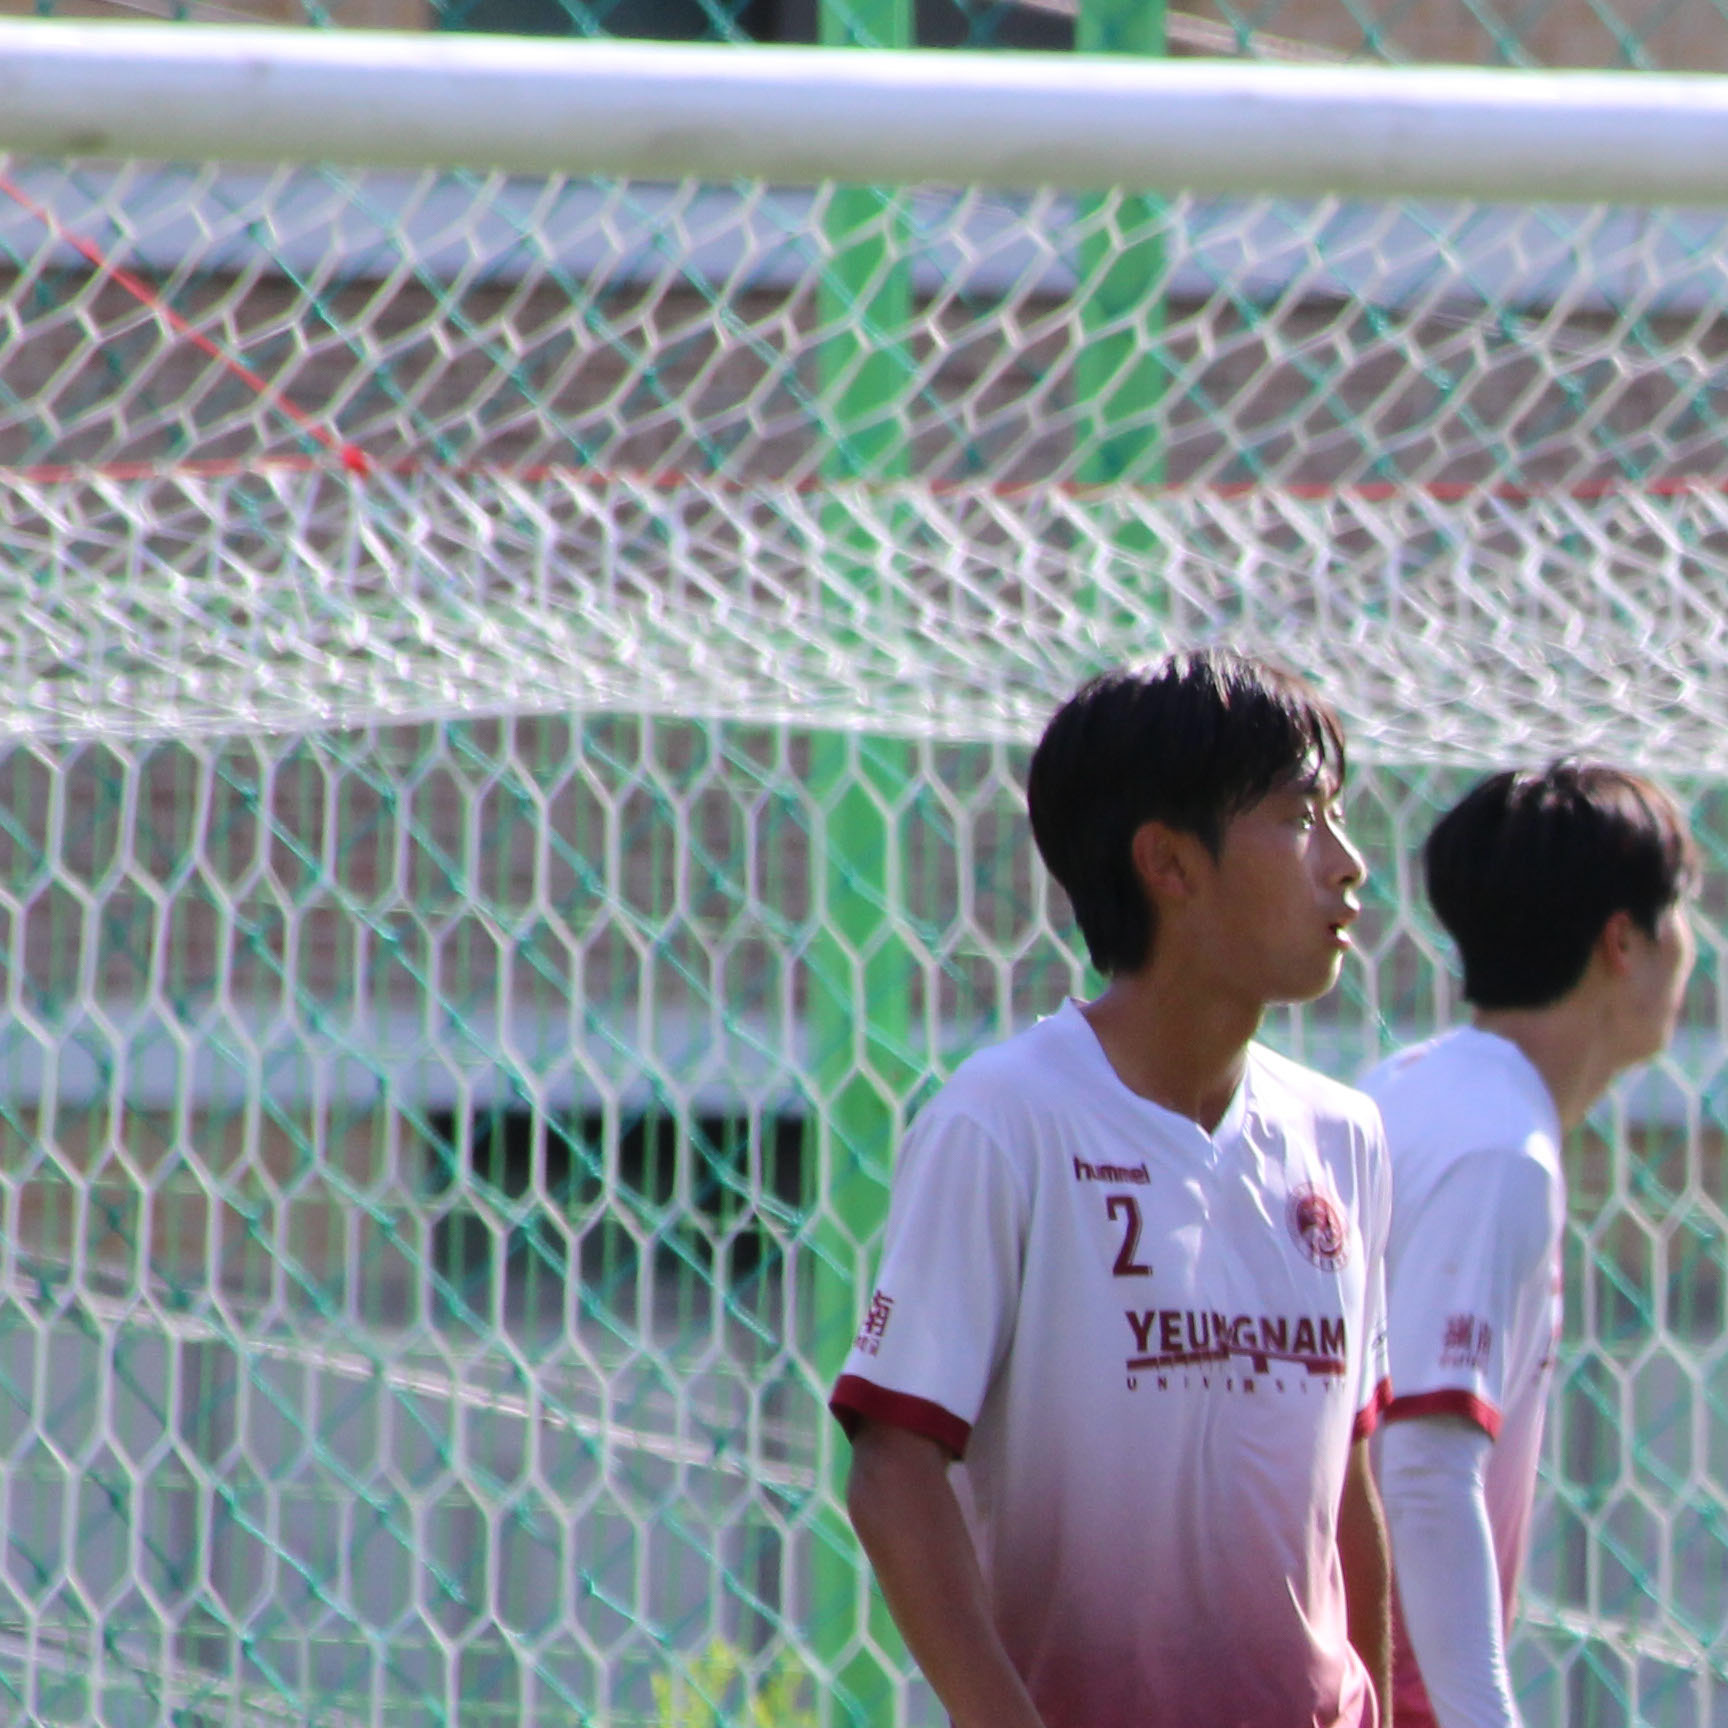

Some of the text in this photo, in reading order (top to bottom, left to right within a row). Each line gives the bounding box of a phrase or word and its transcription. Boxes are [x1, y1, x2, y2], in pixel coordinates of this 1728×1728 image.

[1073, 1156, 1151, 1186] hummel
[1106, 1195, 1153, 1277] 2
[1125, 1309, 1346, 1356] YEUNGNAM
